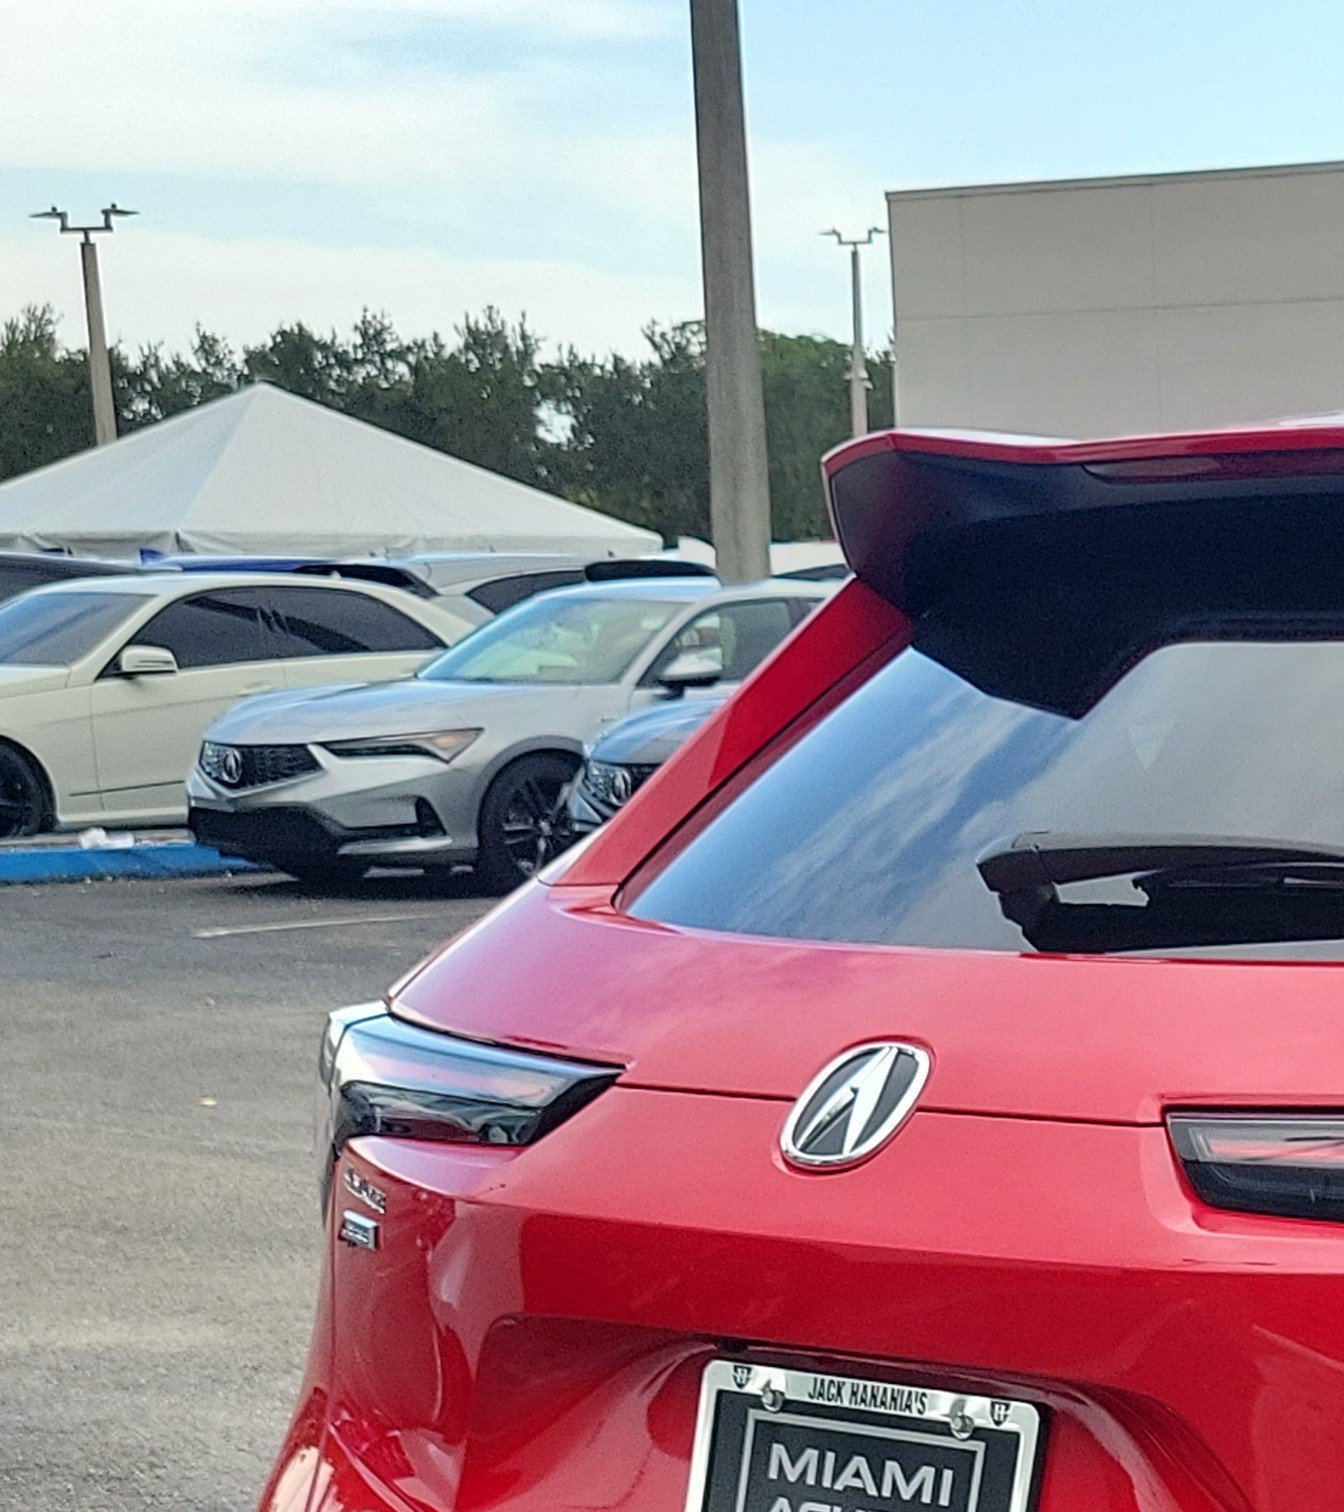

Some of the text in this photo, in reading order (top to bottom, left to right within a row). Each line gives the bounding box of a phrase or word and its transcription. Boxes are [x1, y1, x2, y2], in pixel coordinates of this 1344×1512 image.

[807, 1376, 928, 1415] JACK HANANIA'S
[768, 1443, 955, 1508] MIAMI
